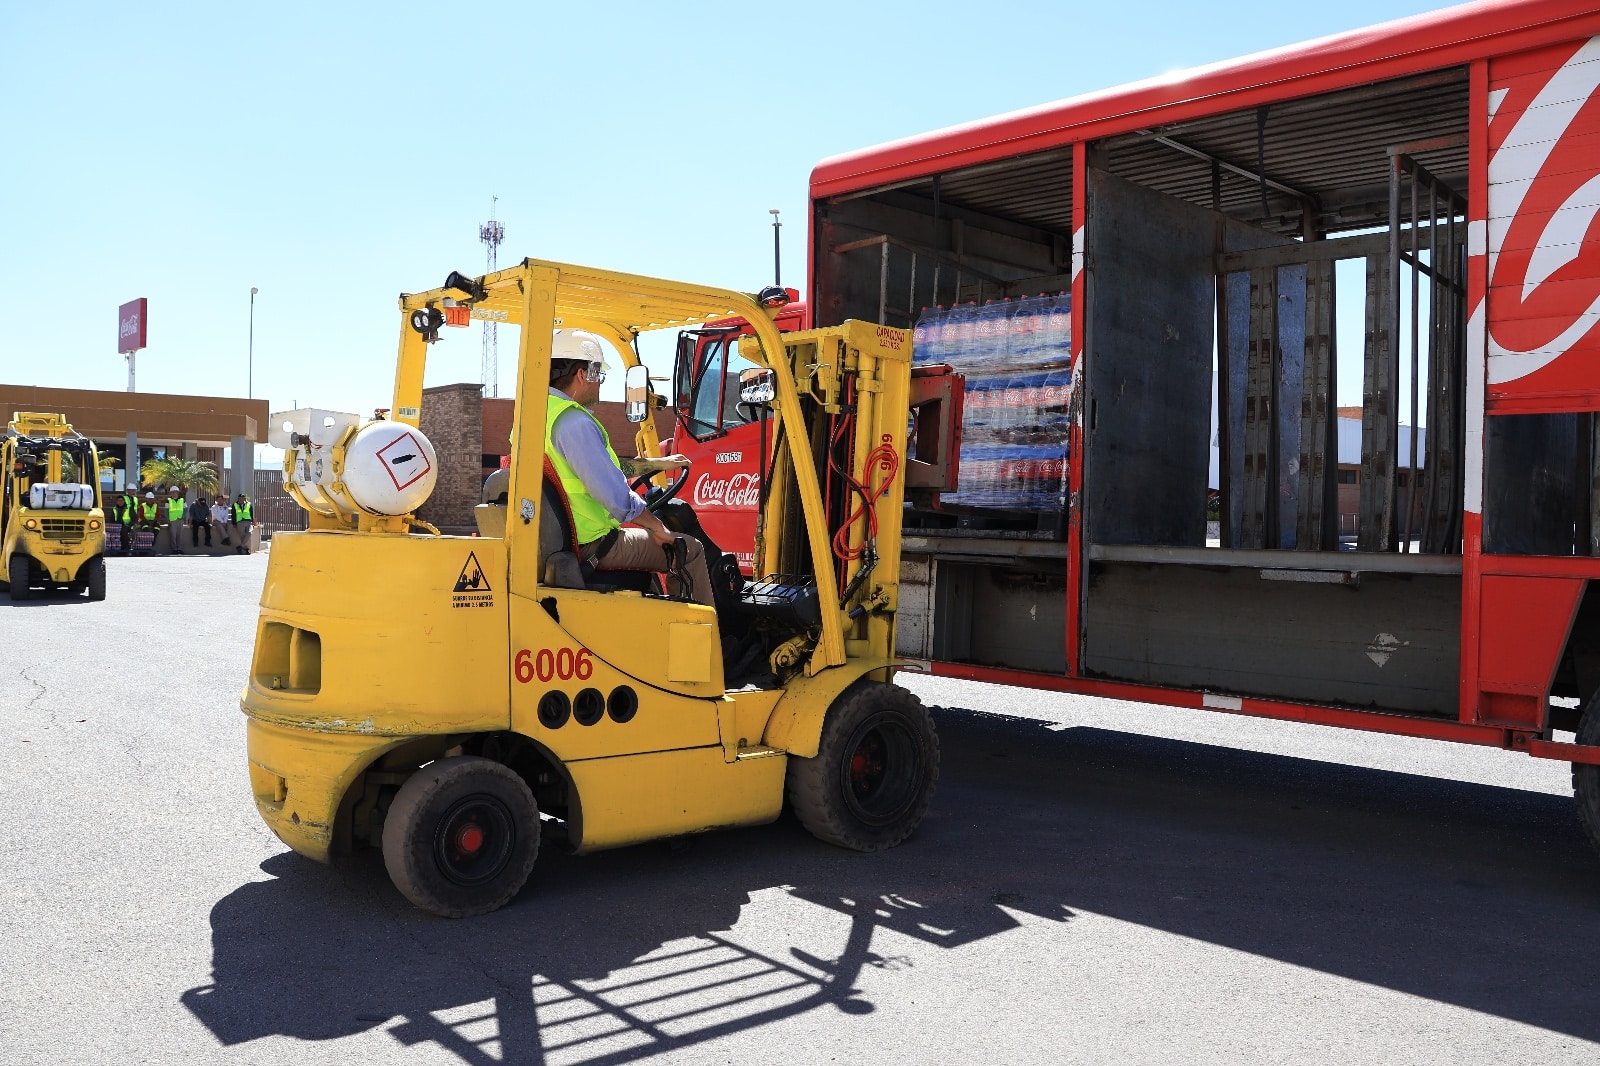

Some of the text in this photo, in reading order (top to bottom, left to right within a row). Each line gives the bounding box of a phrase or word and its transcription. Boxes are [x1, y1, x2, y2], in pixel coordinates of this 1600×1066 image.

[876, 326, 905, 343] CAPACIDAD
[693, 472, 760, 506] Coca-Cola
[514, 647, 593, 684] 6006
